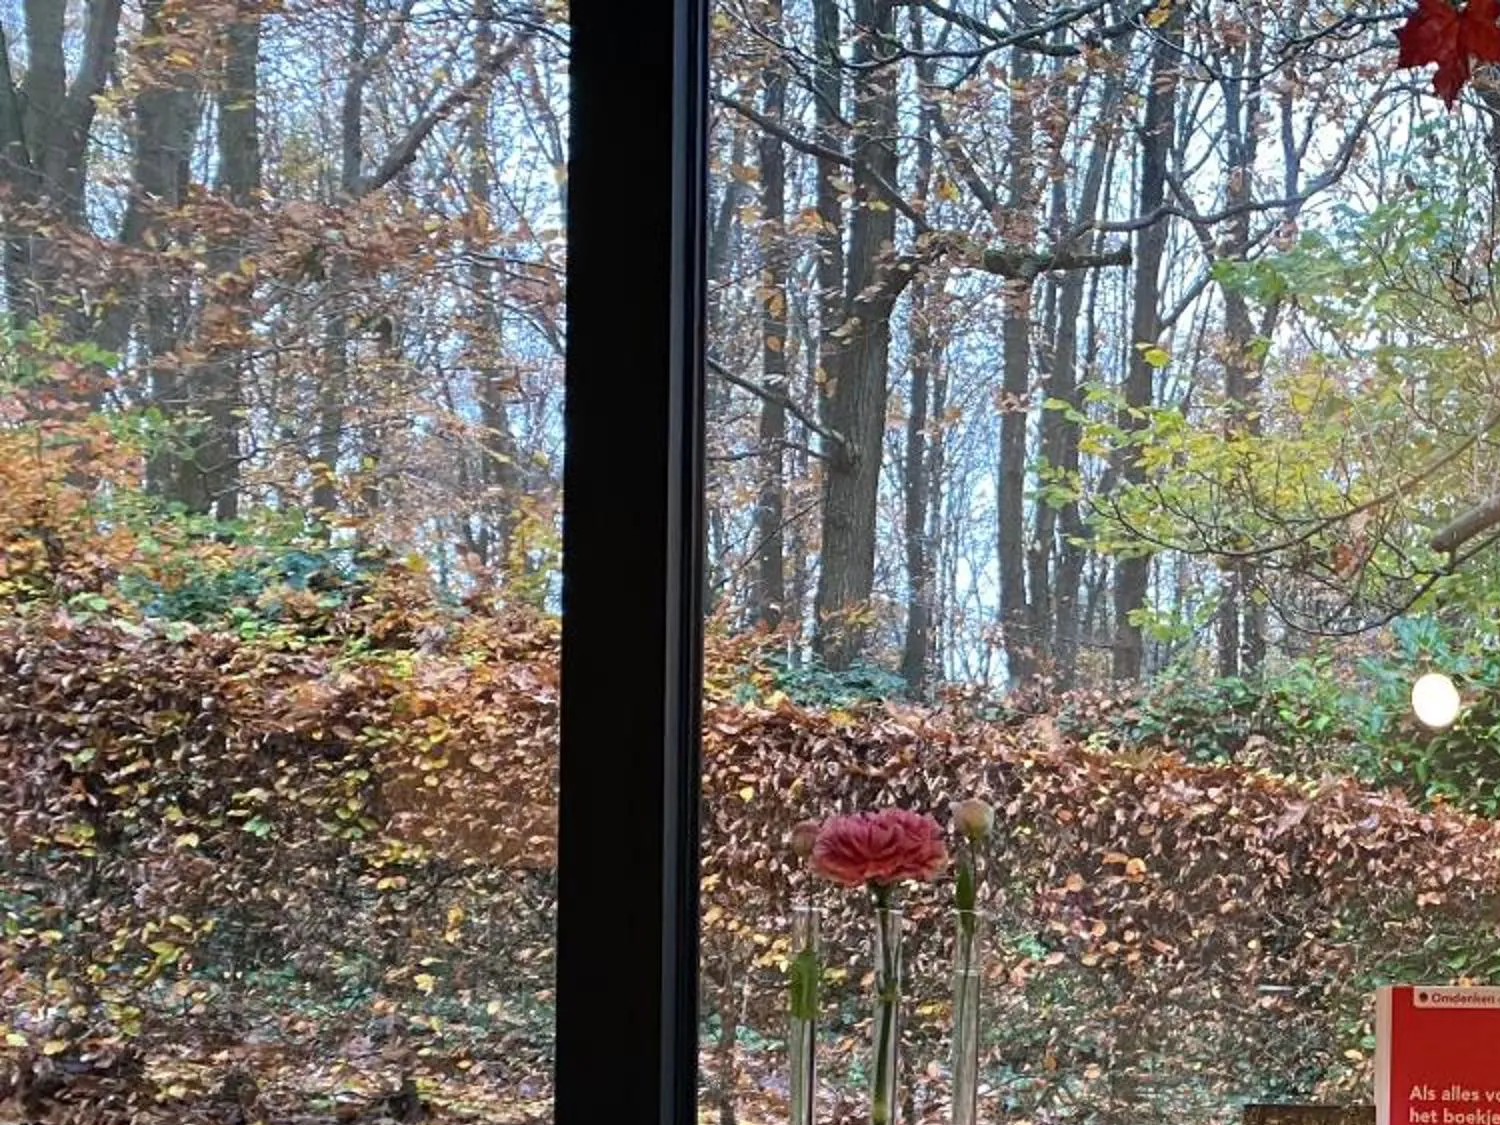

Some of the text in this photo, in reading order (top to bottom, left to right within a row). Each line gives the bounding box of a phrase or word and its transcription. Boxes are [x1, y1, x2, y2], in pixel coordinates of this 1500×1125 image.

[1409, 1085, 1436, 1101] Als
[1442, 1085, 1479, 1101] alles
[1409, 1107, 1438, 1123] het
